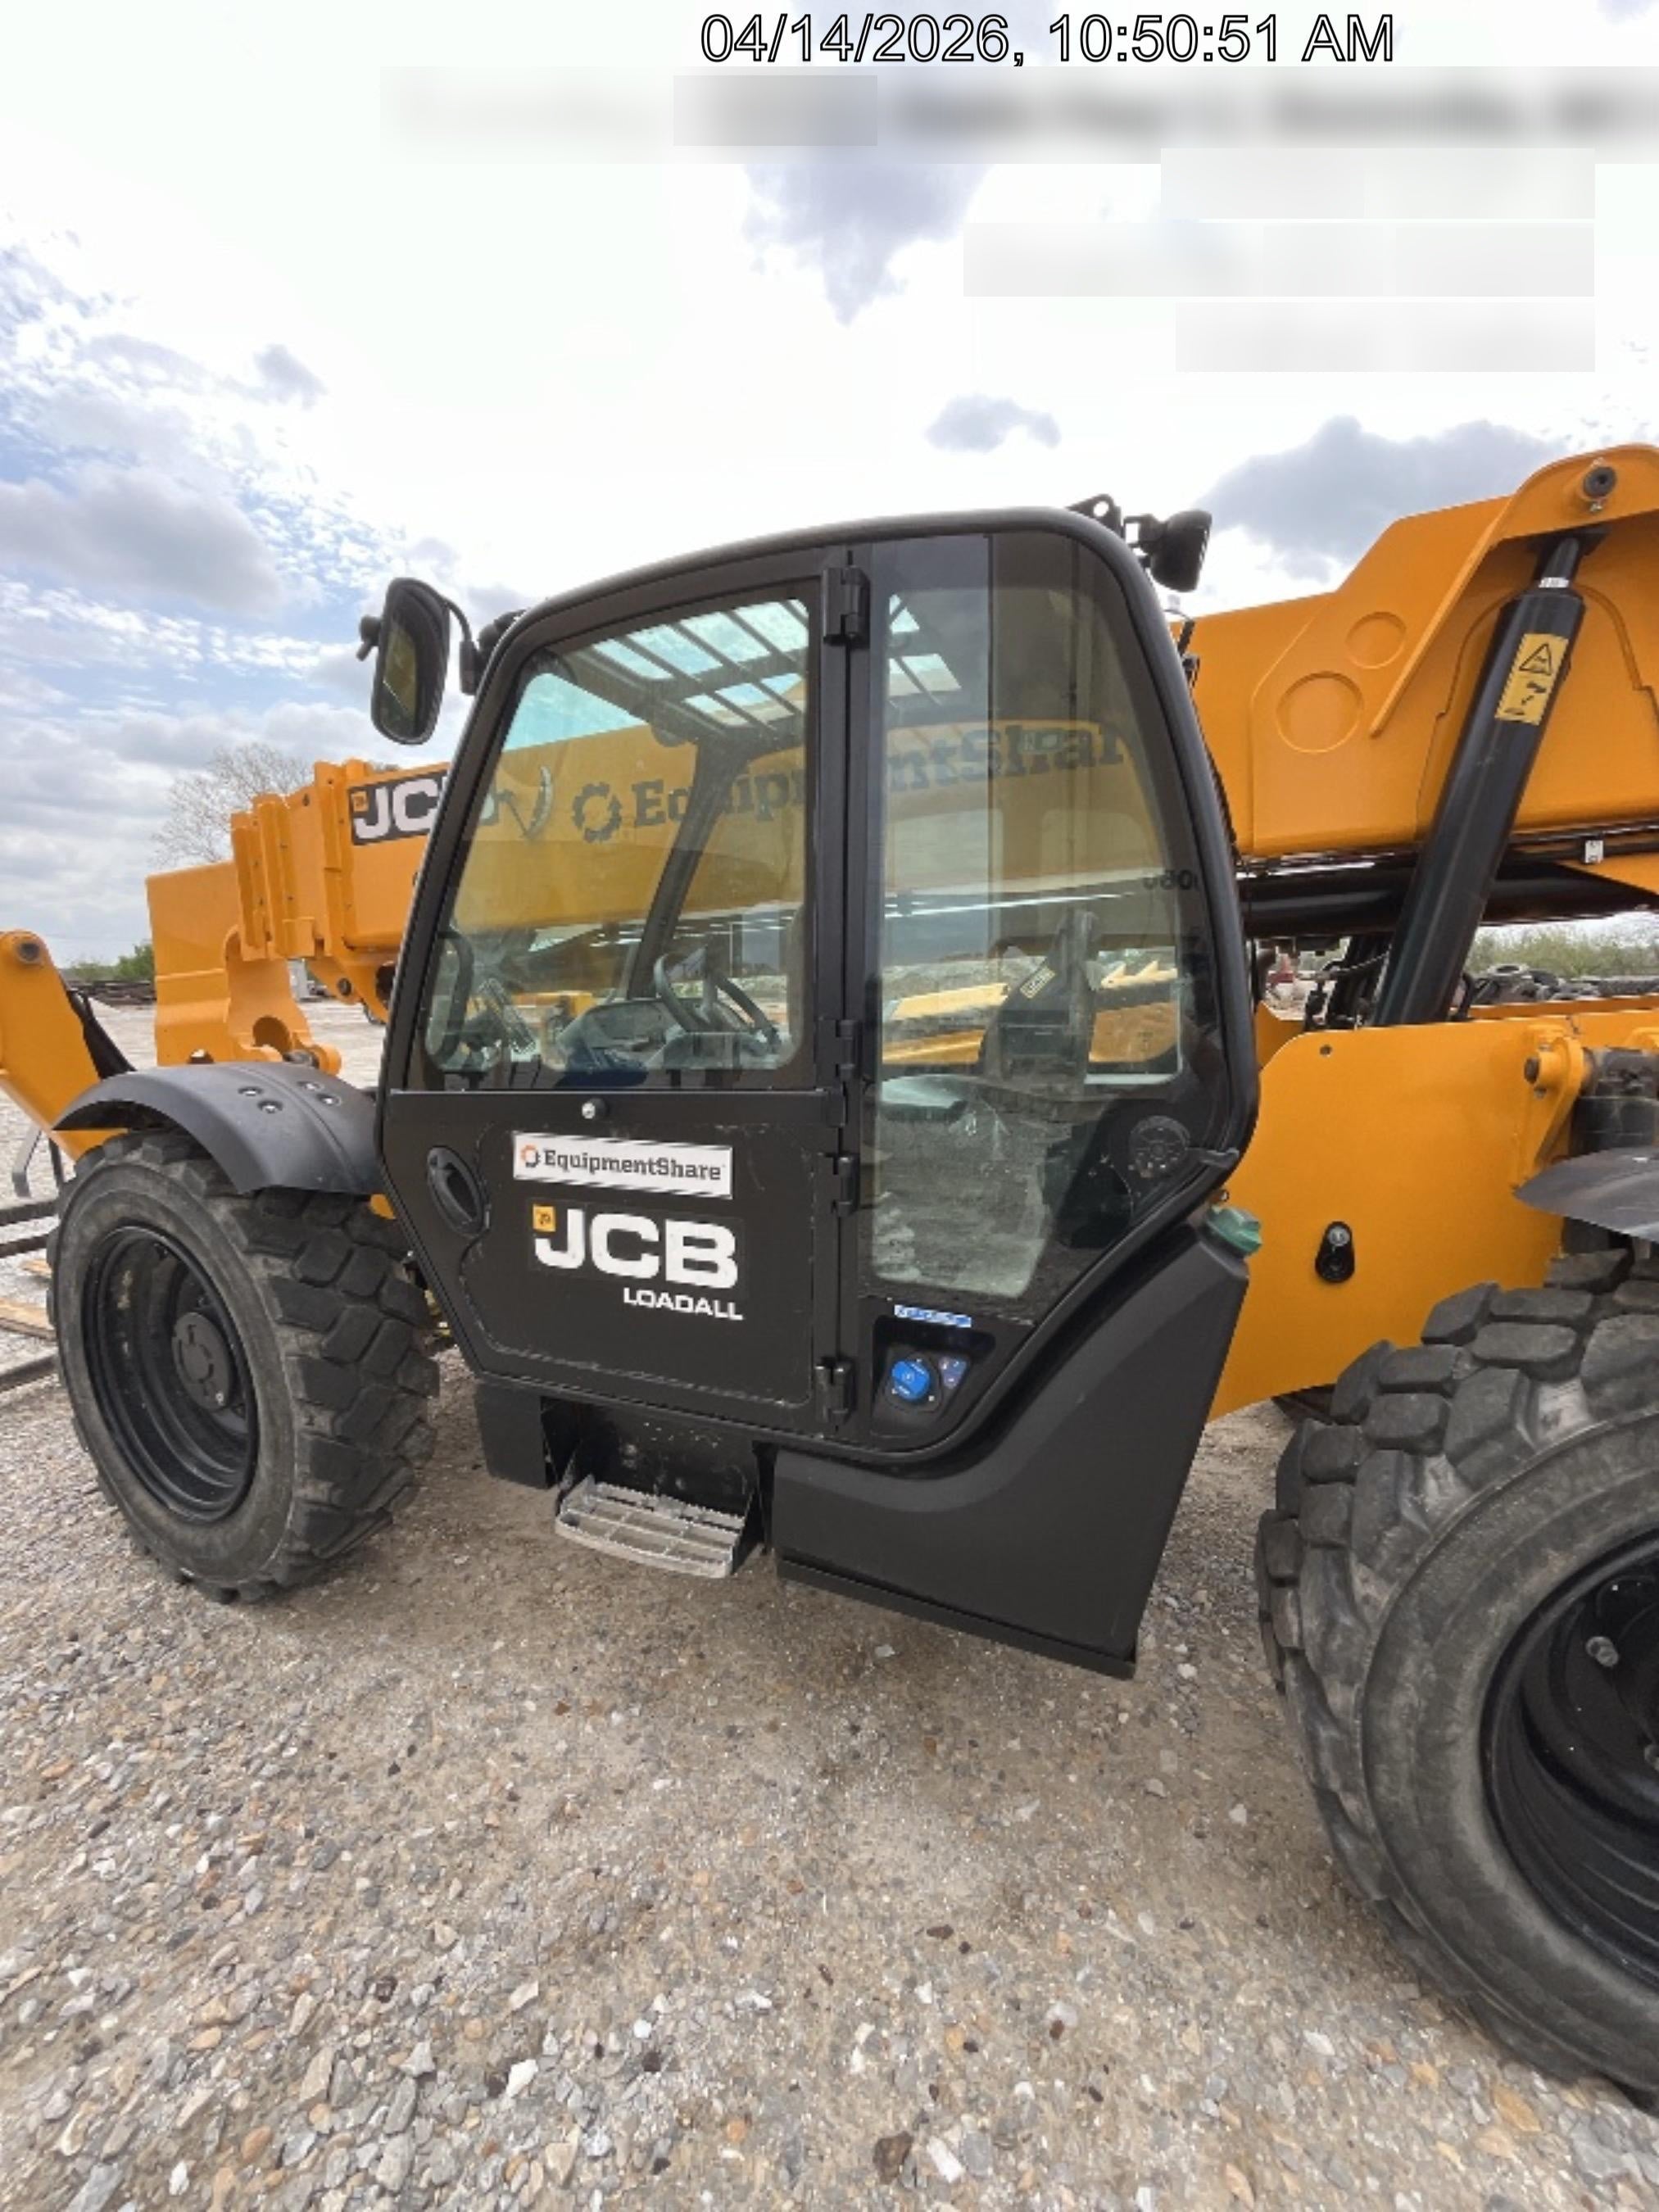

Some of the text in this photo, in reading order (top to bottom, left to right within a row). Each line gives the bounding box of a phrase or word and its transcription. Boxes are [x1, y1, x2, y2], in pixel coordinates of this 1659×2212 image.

[353, 775, 449, 840] JC
[544, 1149, 721, 1181] EquipmentShare
[534, 1208, 737, 1289] JCB
[623, 1287, 744, 1321] LOADALL
